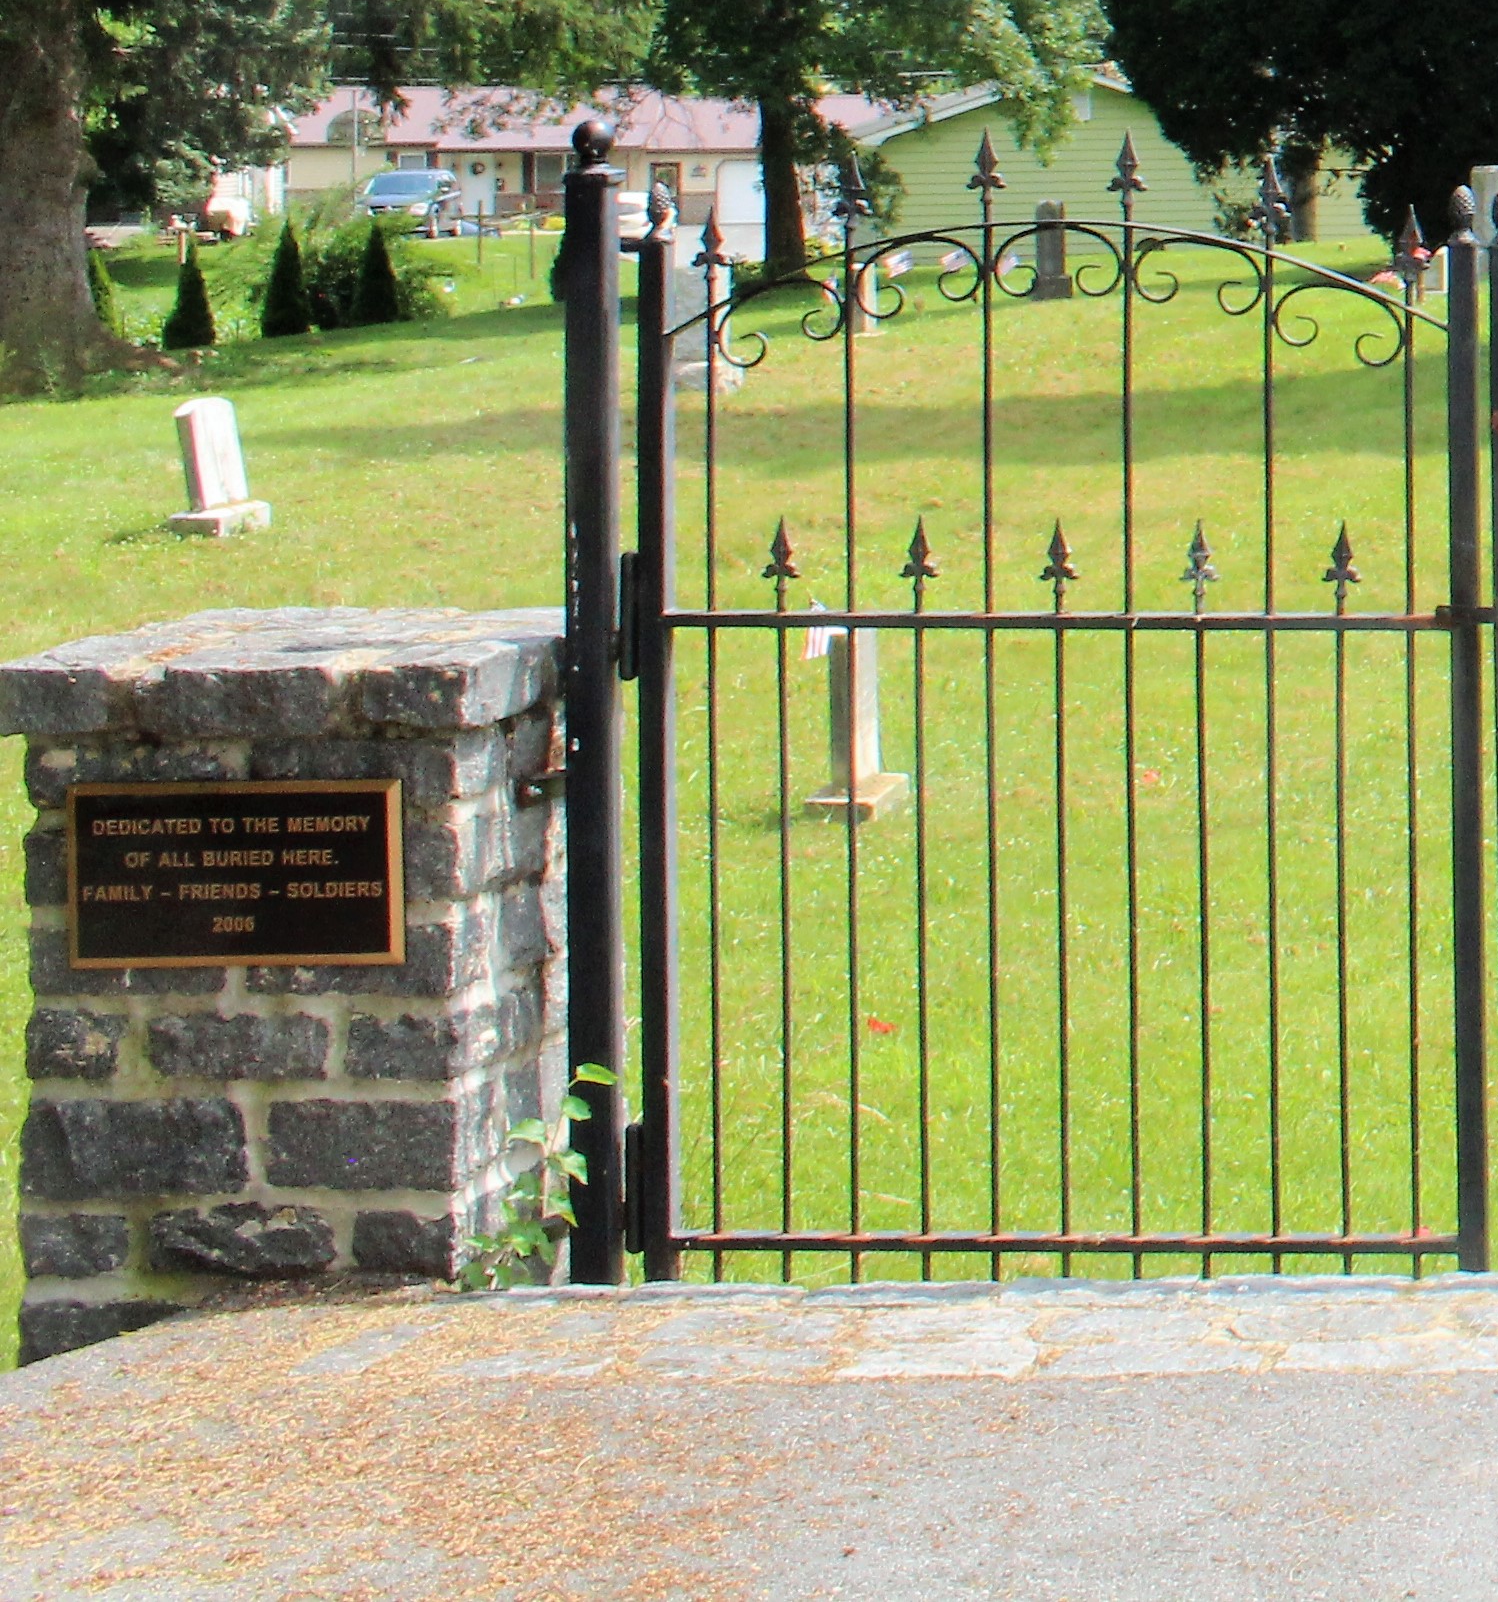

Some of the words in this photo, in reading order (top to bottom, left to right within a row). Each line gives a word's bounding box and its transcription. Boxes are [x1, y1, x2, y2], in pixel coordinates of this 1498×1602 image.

[92, 818, 201, 836] DEDICATED
[209, 817, 235, 834] TO
[242, 817, 280, 833] THE
[287, 816, 371, 833] MEMORY
[125, 851, 151, 869] OF
[158, 851, 195, 868] ALL
[202, 850, 274, 867] BURIED
[282, 849, 340, 866] HERE.
[82, 885, 152, 901] FAMILY
[178, 883, 262, 900] FRIENDS
[287, 881, 383, 898] SOLDIERS
[212, 916, 256, 932] 2006
